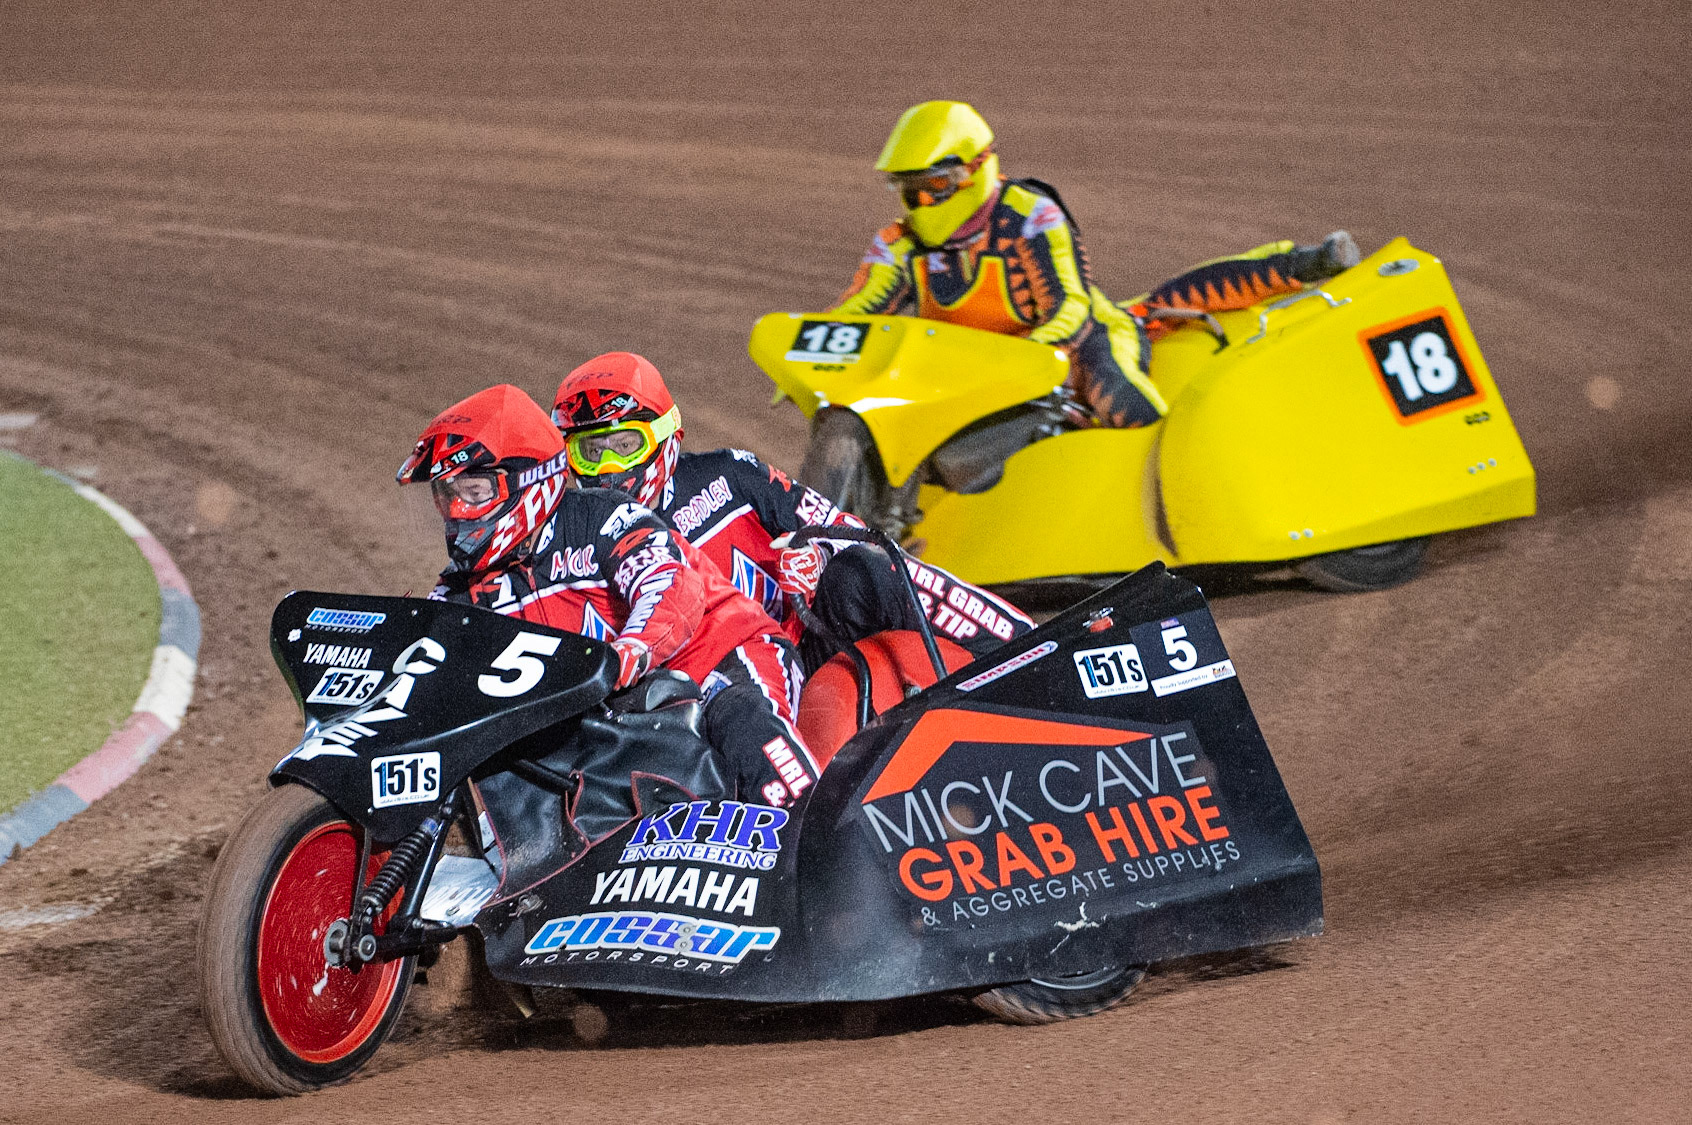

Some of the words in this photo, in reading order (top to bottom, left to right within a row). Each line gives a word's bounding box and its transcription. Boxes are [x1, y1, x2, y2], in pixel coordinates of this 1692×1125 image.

[803, 325, 861, 354] 18
[1382, 331, 1458, 401] 18
[451, 450, 469, 464] 18
[672, 475, 733, 537] BRADLEY
[931, 603, 978, 641] TIP
[948, 585, 1014, 641] GRAB
[302, 642, 373, 669] YAMAHA
[477, 631, 562, 697] 5
[1078, 650, 1143, 688] 151's
[1160, 624, 1198, 672] 5
[316, 672, 375, 700] 151's
[374, 758, 437, 797] 151's
[763, 736, 812, 799] MRL
[862, 770, 1034, 853] MICK
[1039, 731, 1207, 814] CAVE
[626, 800, 790, 852] KHR
[898, 822, 1077, 901] GRAB
[1085, 786, 1230, 863] HIRE
[618, 843, 778, 871] ENGINEERING
[589, 866, 760, 916] YAMAHA
[921, 906, 940, 926] &
[953, 867, 1115, 921] AGGREGATE
[1123, 840, 1241, 882] SUPPLIES
[519, 951, 735, 975] MOTORSPORT
